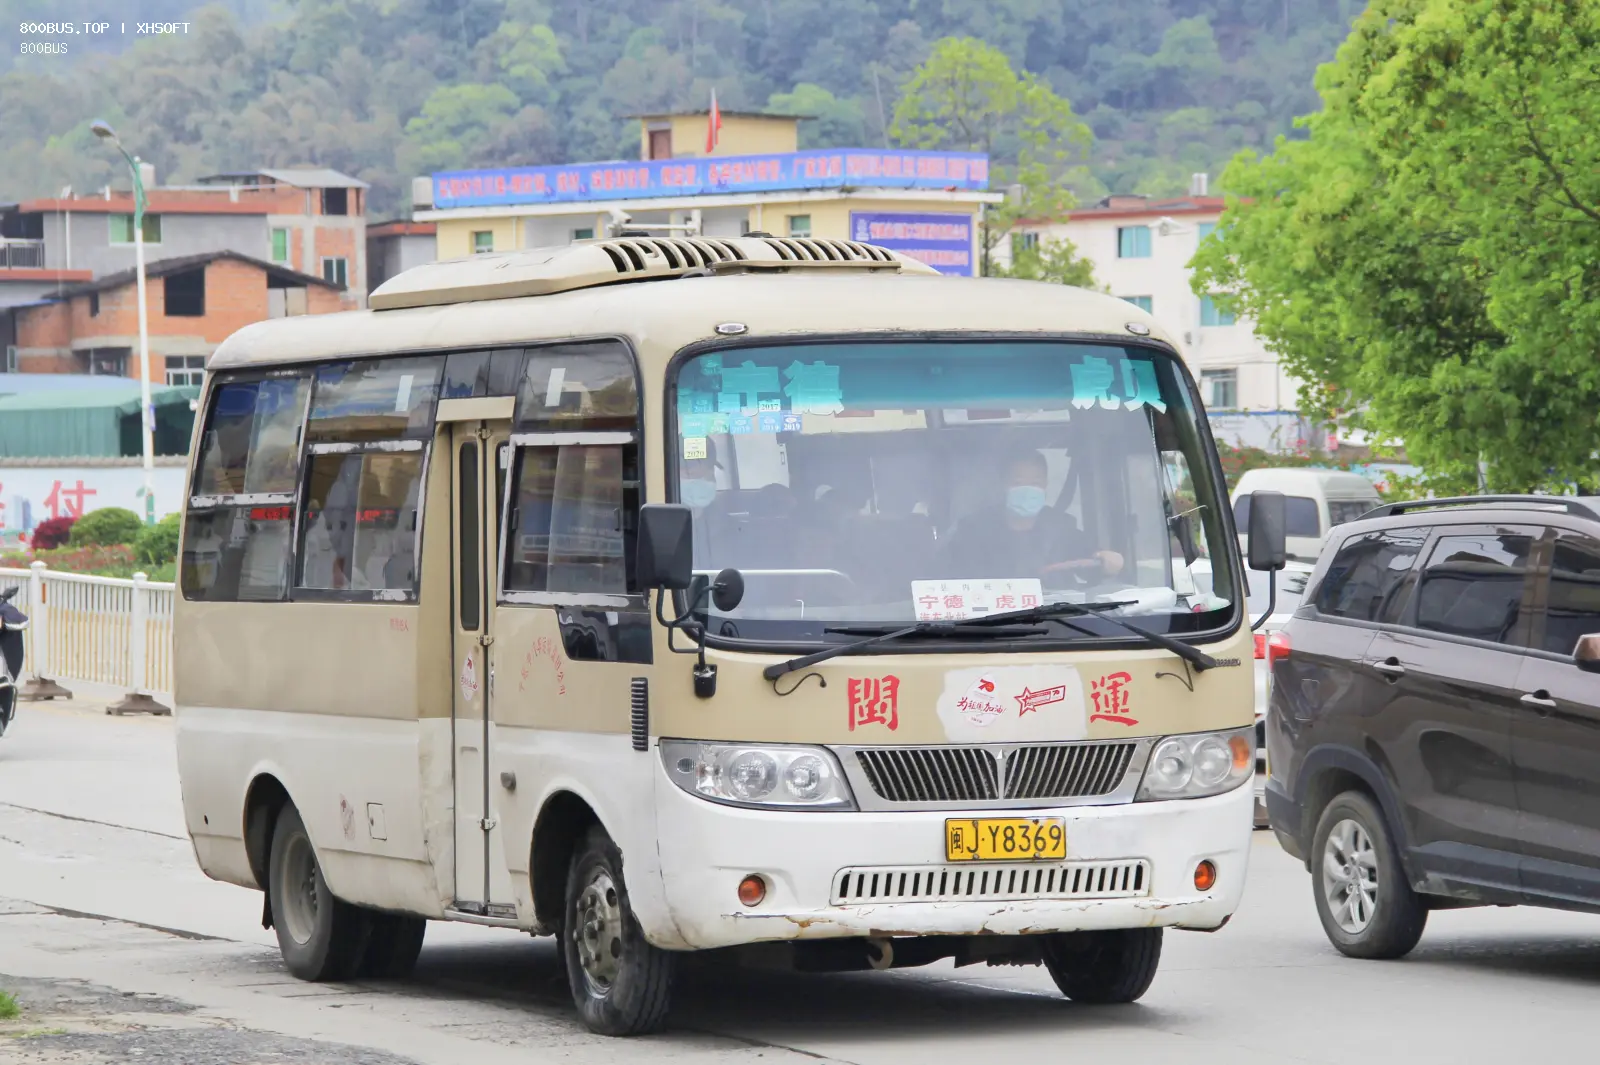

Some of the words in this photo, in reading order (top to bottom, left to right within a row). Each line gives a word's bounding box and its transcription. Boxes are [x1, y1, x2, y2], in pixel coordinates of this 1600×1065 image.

[783, 422, 801, 431] 2019
[686, 450, 705, 458] 2020
[918, 594, 965, 610] 宁德
[995, 594, 1038, 610] 虎贝
